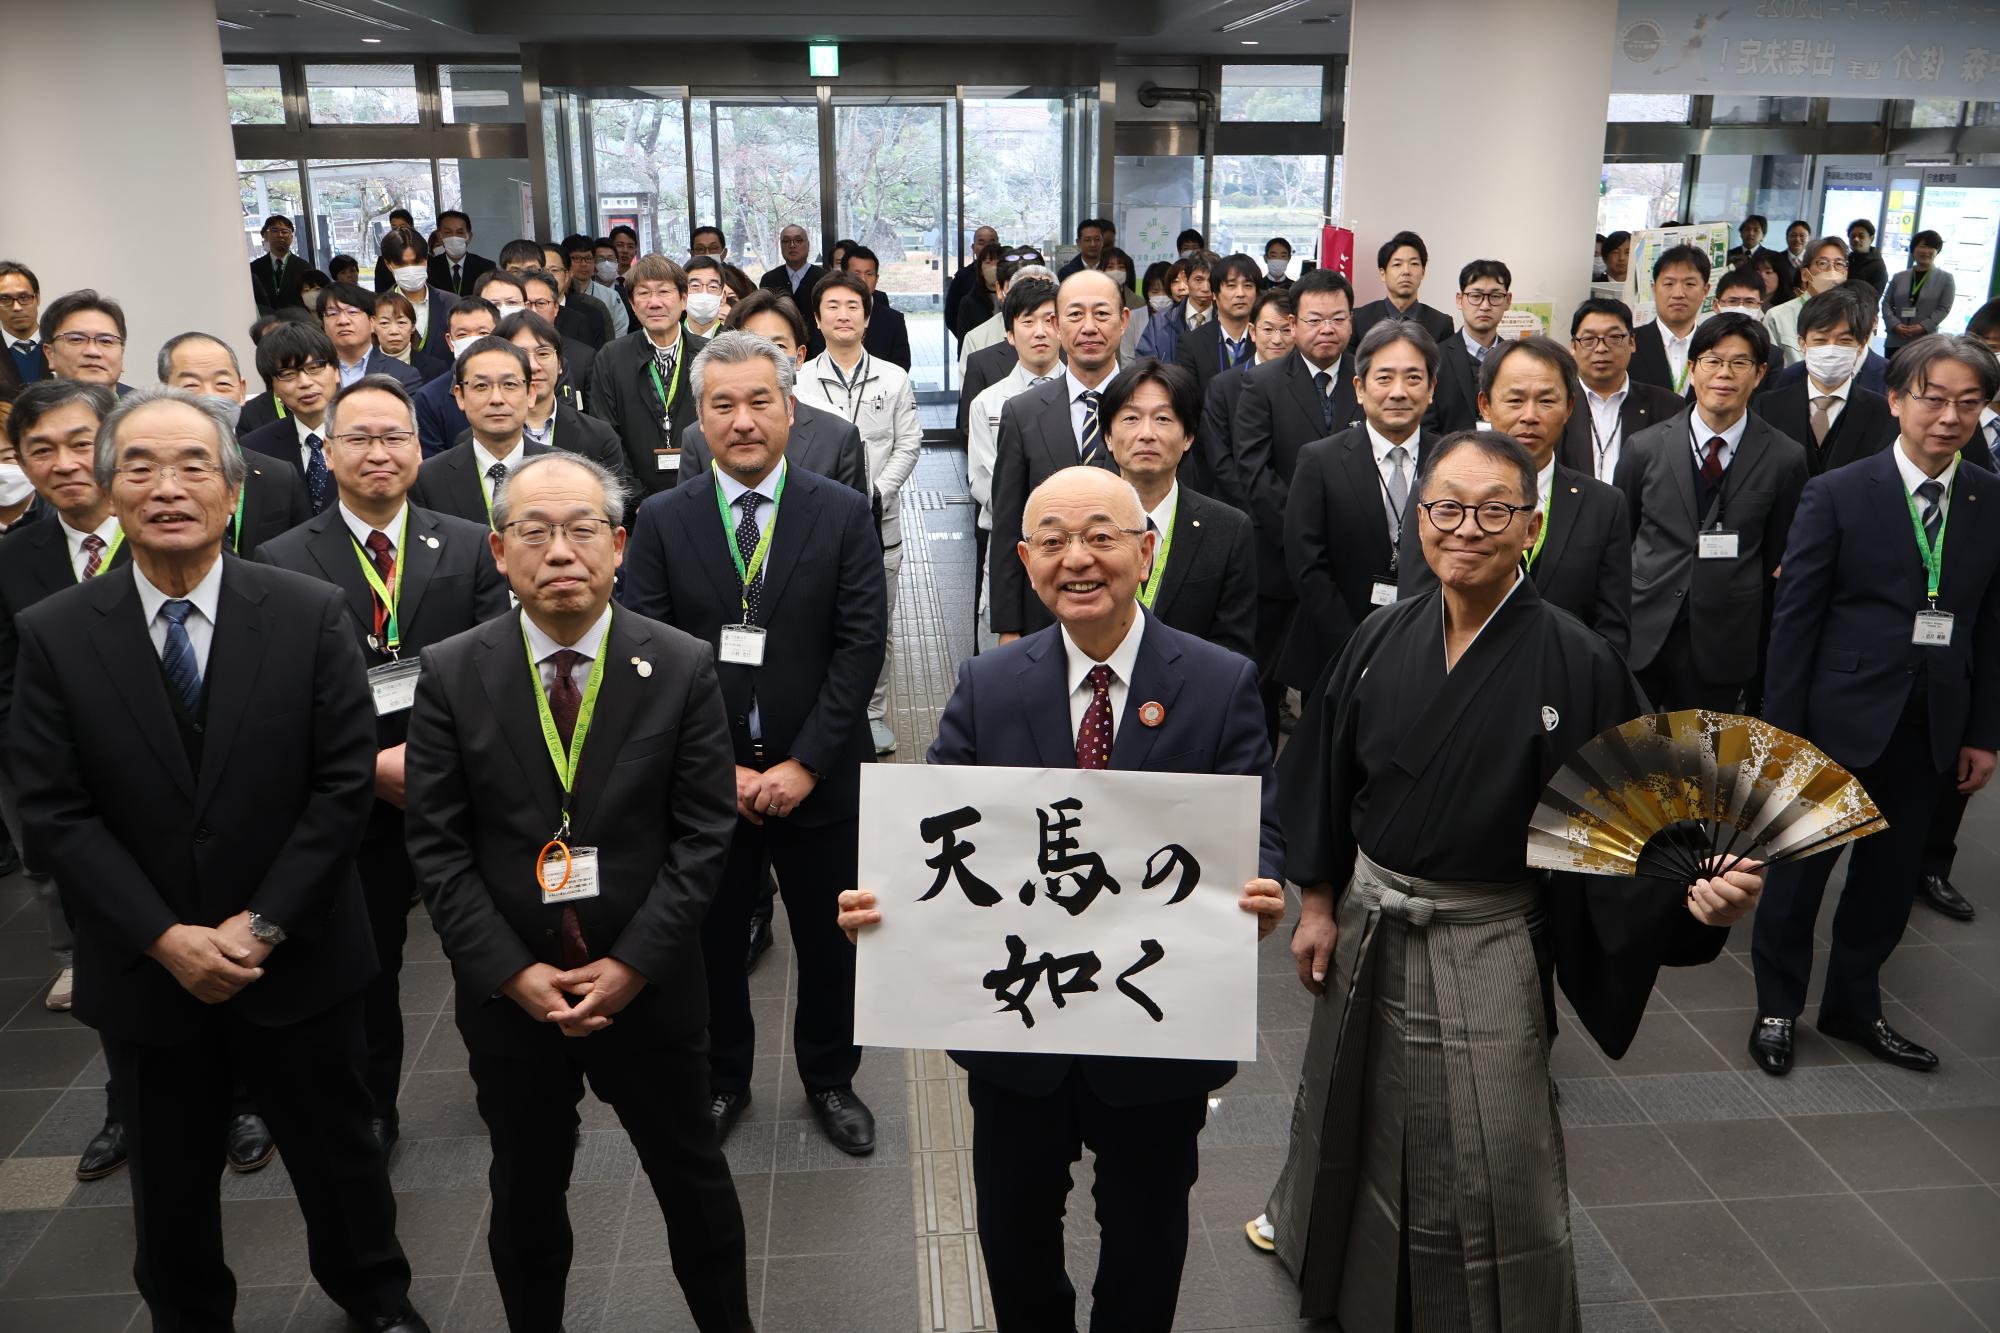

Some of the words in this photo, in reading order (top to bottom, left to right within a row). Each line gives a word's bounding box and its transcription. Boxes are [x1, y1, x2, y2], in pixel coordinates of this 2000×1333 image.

[914, 797, 1201, 916] 天馬の
[983, 934, 1165, 1029] 如く
